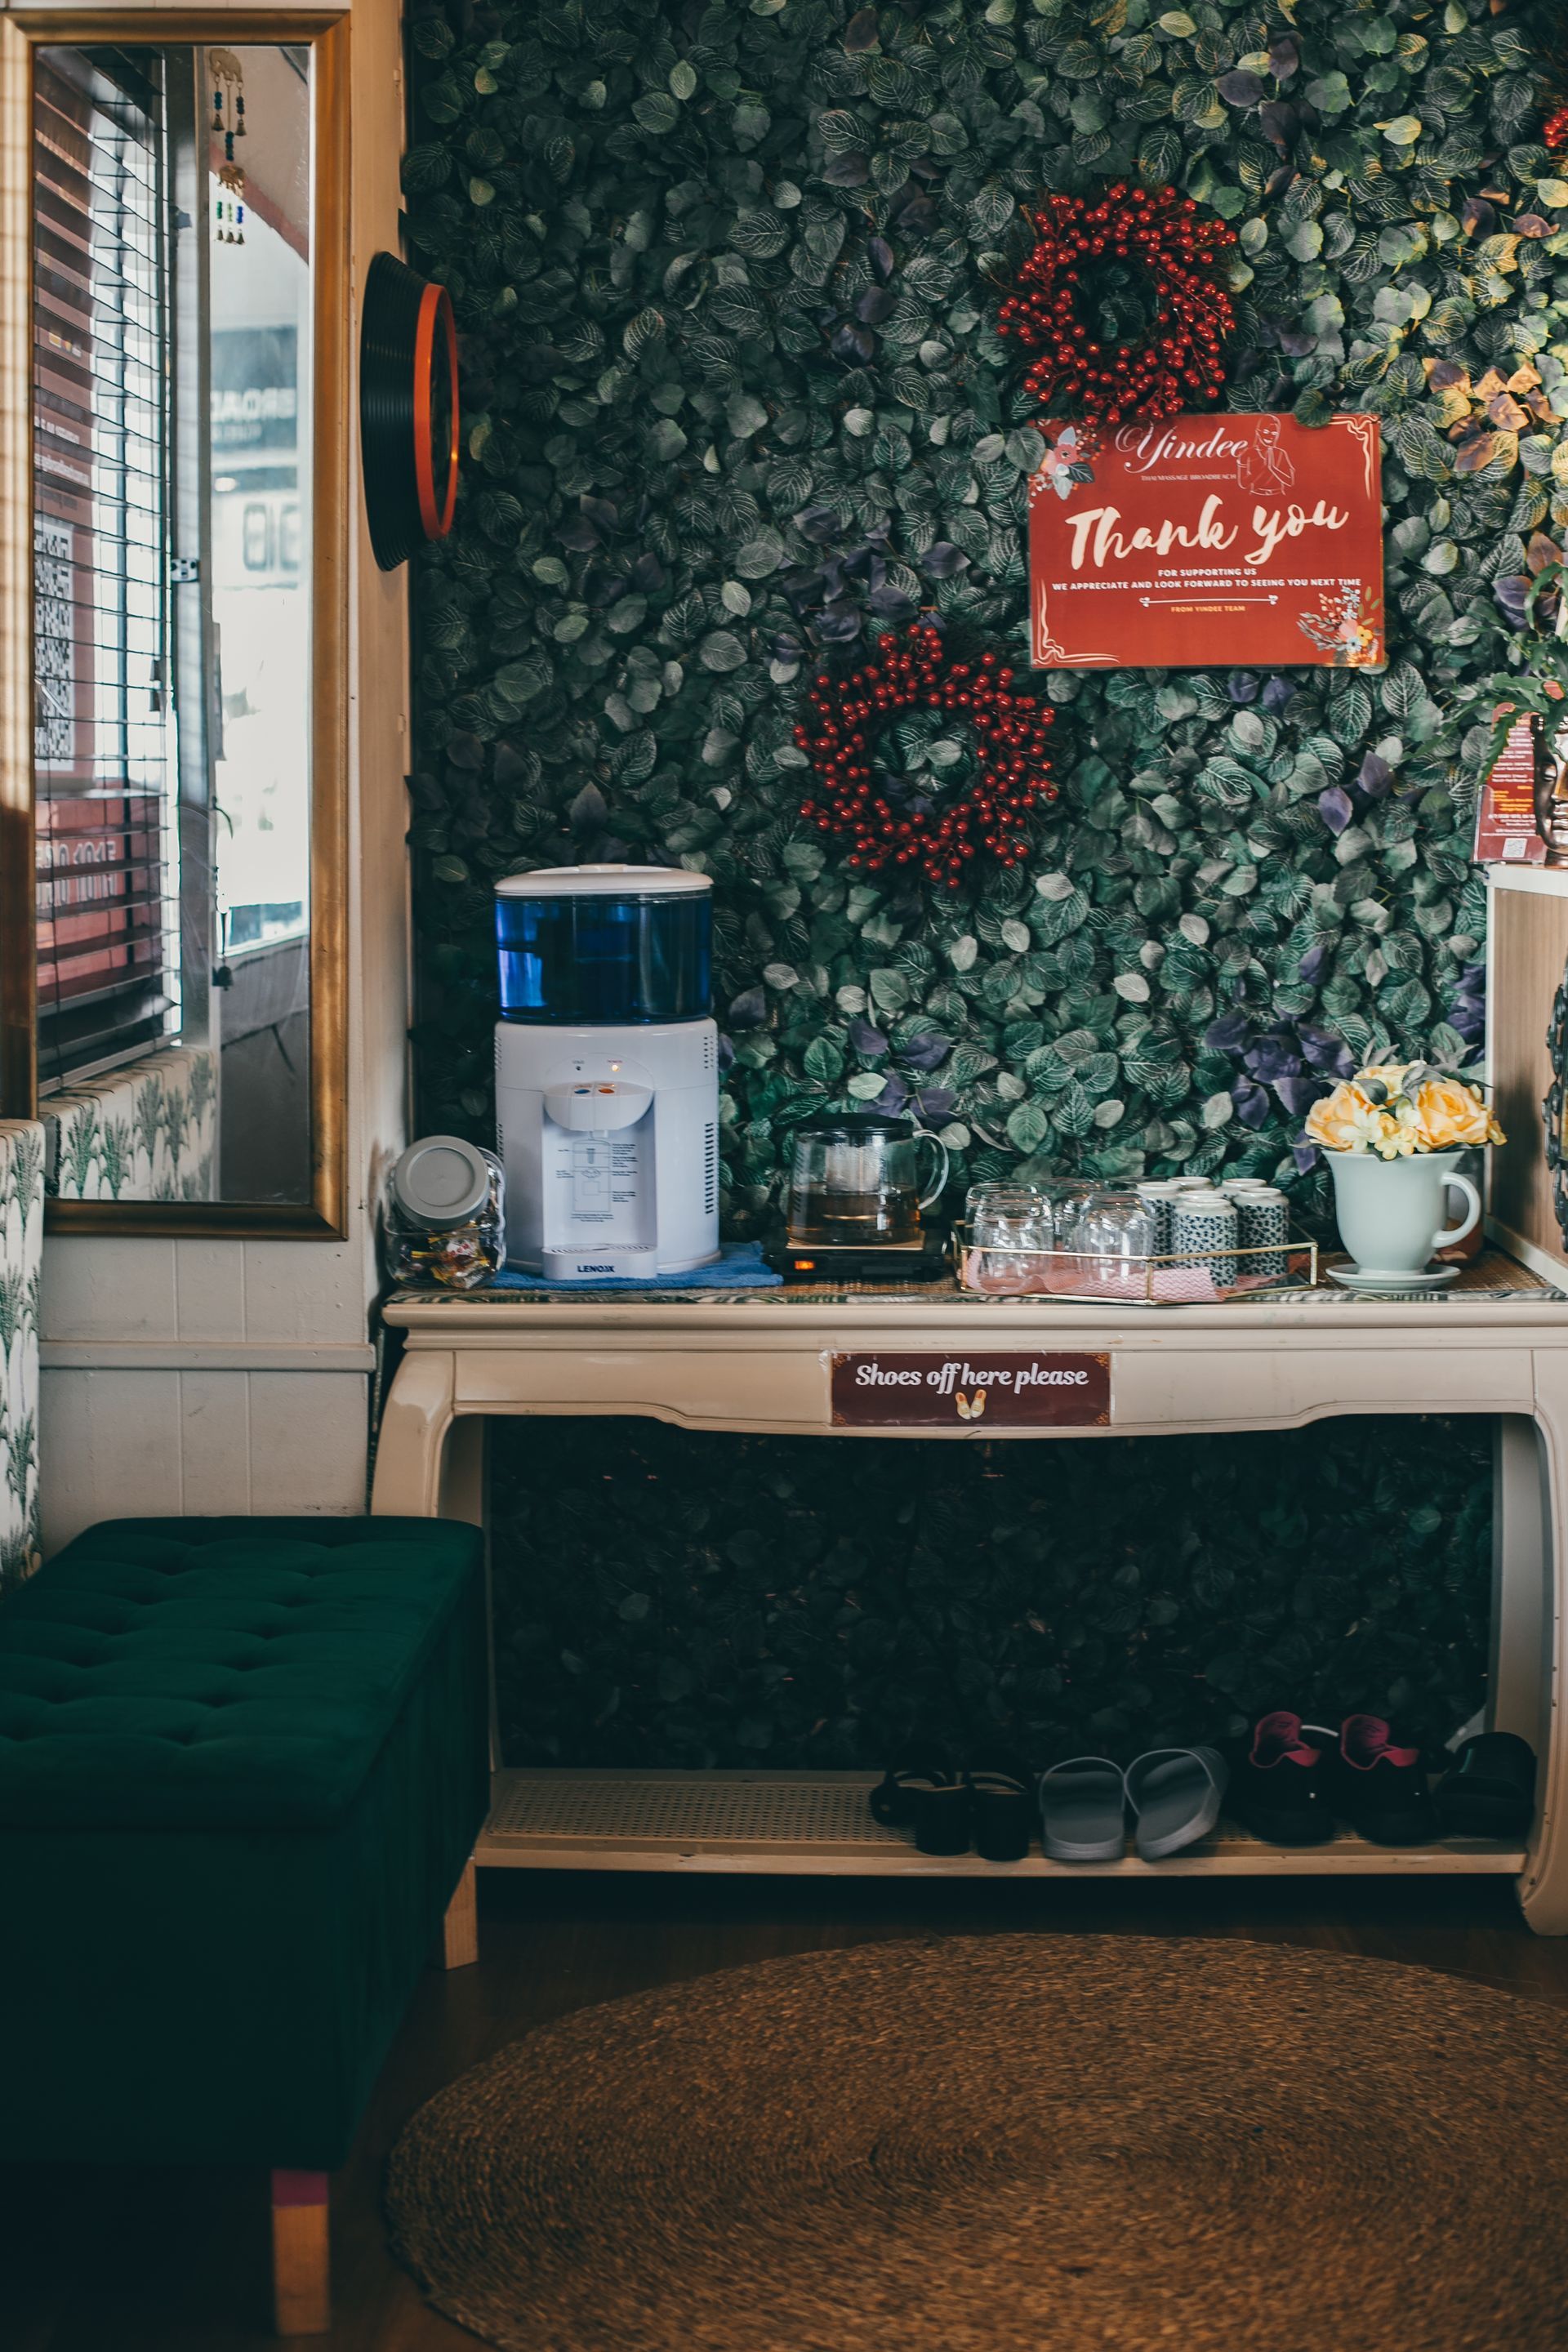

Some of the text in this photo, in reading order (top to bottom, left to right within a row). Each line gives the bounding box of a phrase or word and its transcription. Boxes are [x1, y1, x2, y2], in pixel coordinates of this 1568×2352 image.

[1116, 417, 1248, 474] Yindee
[1065, 494, 1349, 570] Thank you
[1070, 581, 1129, 590] APPRECIATE
[1131, 581, 1152, 589] AND
[1184, 580, 1232, 588] FORWARD
[1287, 578, 1308, 586] YOU
[1179, 568, 1241, 577] SUPPORTING
[855, 1362, 1089, 1394] Shoes off here please
